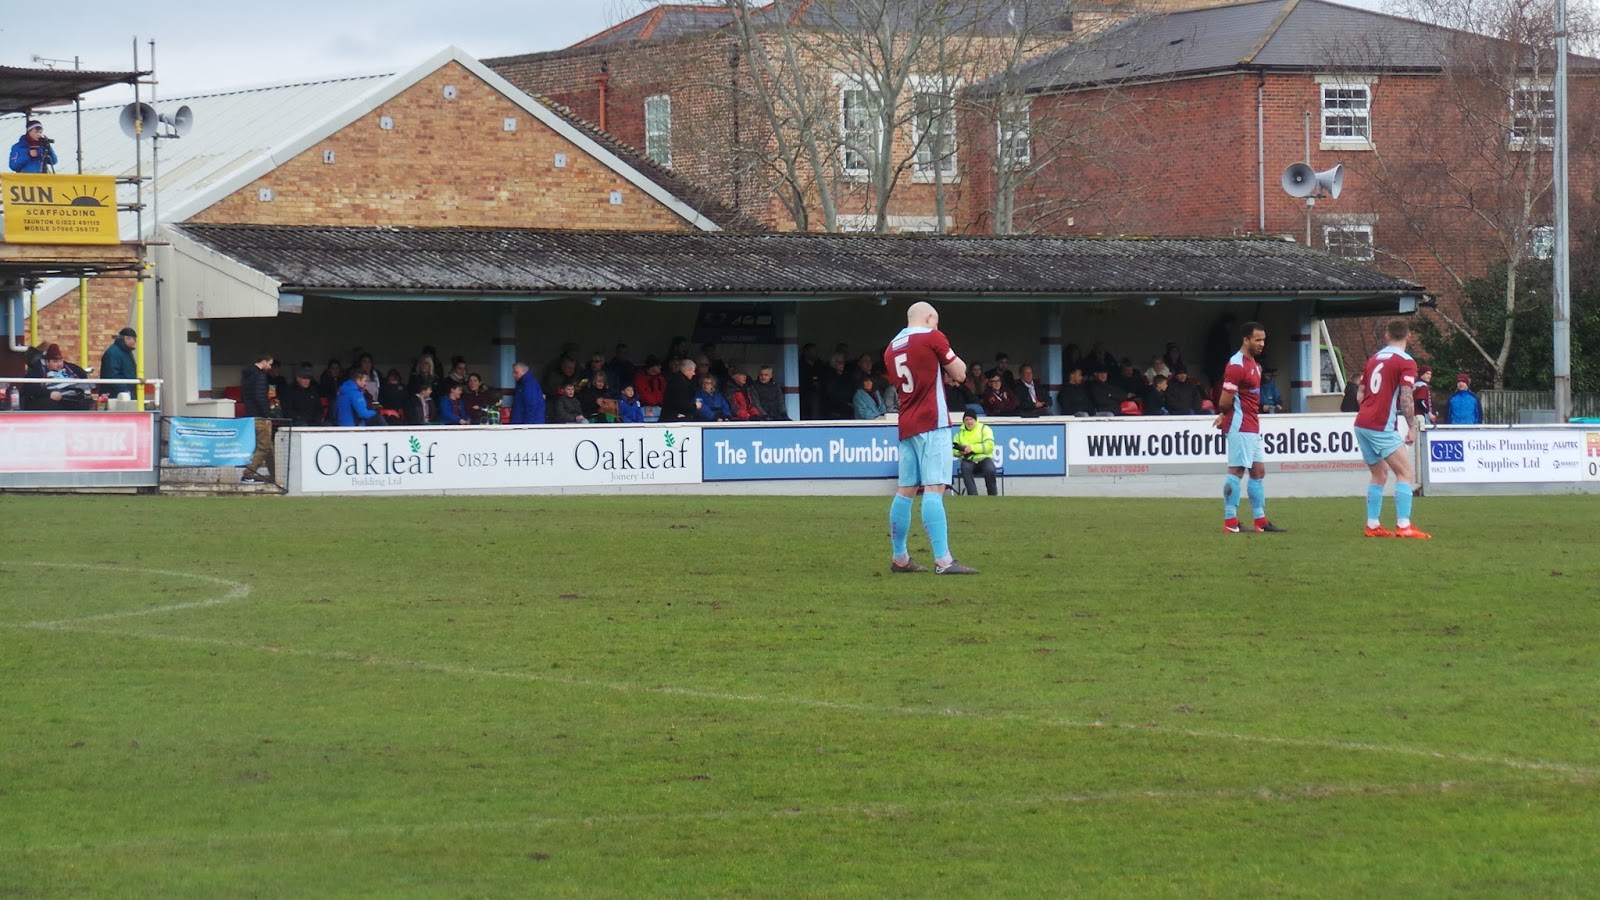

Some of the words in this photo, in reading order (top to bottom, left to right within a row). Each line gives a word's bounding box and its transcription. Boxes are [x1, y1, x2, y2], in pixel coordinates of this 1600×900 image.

[10, 186, 54, 203] SUN
[26, 209, 96, 217] SCAFFOLDING
[894, 352, 914, 394] 5
[1369, 362, 1383, 395] 6
[714, 440, 748, 465] The
[751, 439, 823, 464] Taunton
[828, 438, 899, 463] Plumbin
[1008, 436, 1058, 461] Stand
[1431, 443, 1463, 460] GPS
[1467, 439, 1497, 451] Gibbs
[1499, 439, 1549, 454] Plumbing
[1552, 441, 1579, 449] ALUTEC
[315, 441, 438, 476] Oakleaf
[457, 452, 498, 468] 01823
[503, 451, 555, 467] 444414
[574, 436, 690, 471] Oakleaf
[1280, 462, 1300, 470] Email:
[1477, 458, 1520, 473] Supplies
[1523, 457, 1540, 469] Ltd
[1588, 461, 1600, 476] 0
[351, 477, 385, 487] Building
[388, 476, 402, 486] Ltd
[610, 471, 638, 482] Joinery
[641, 470, 655, 480] Ltd
